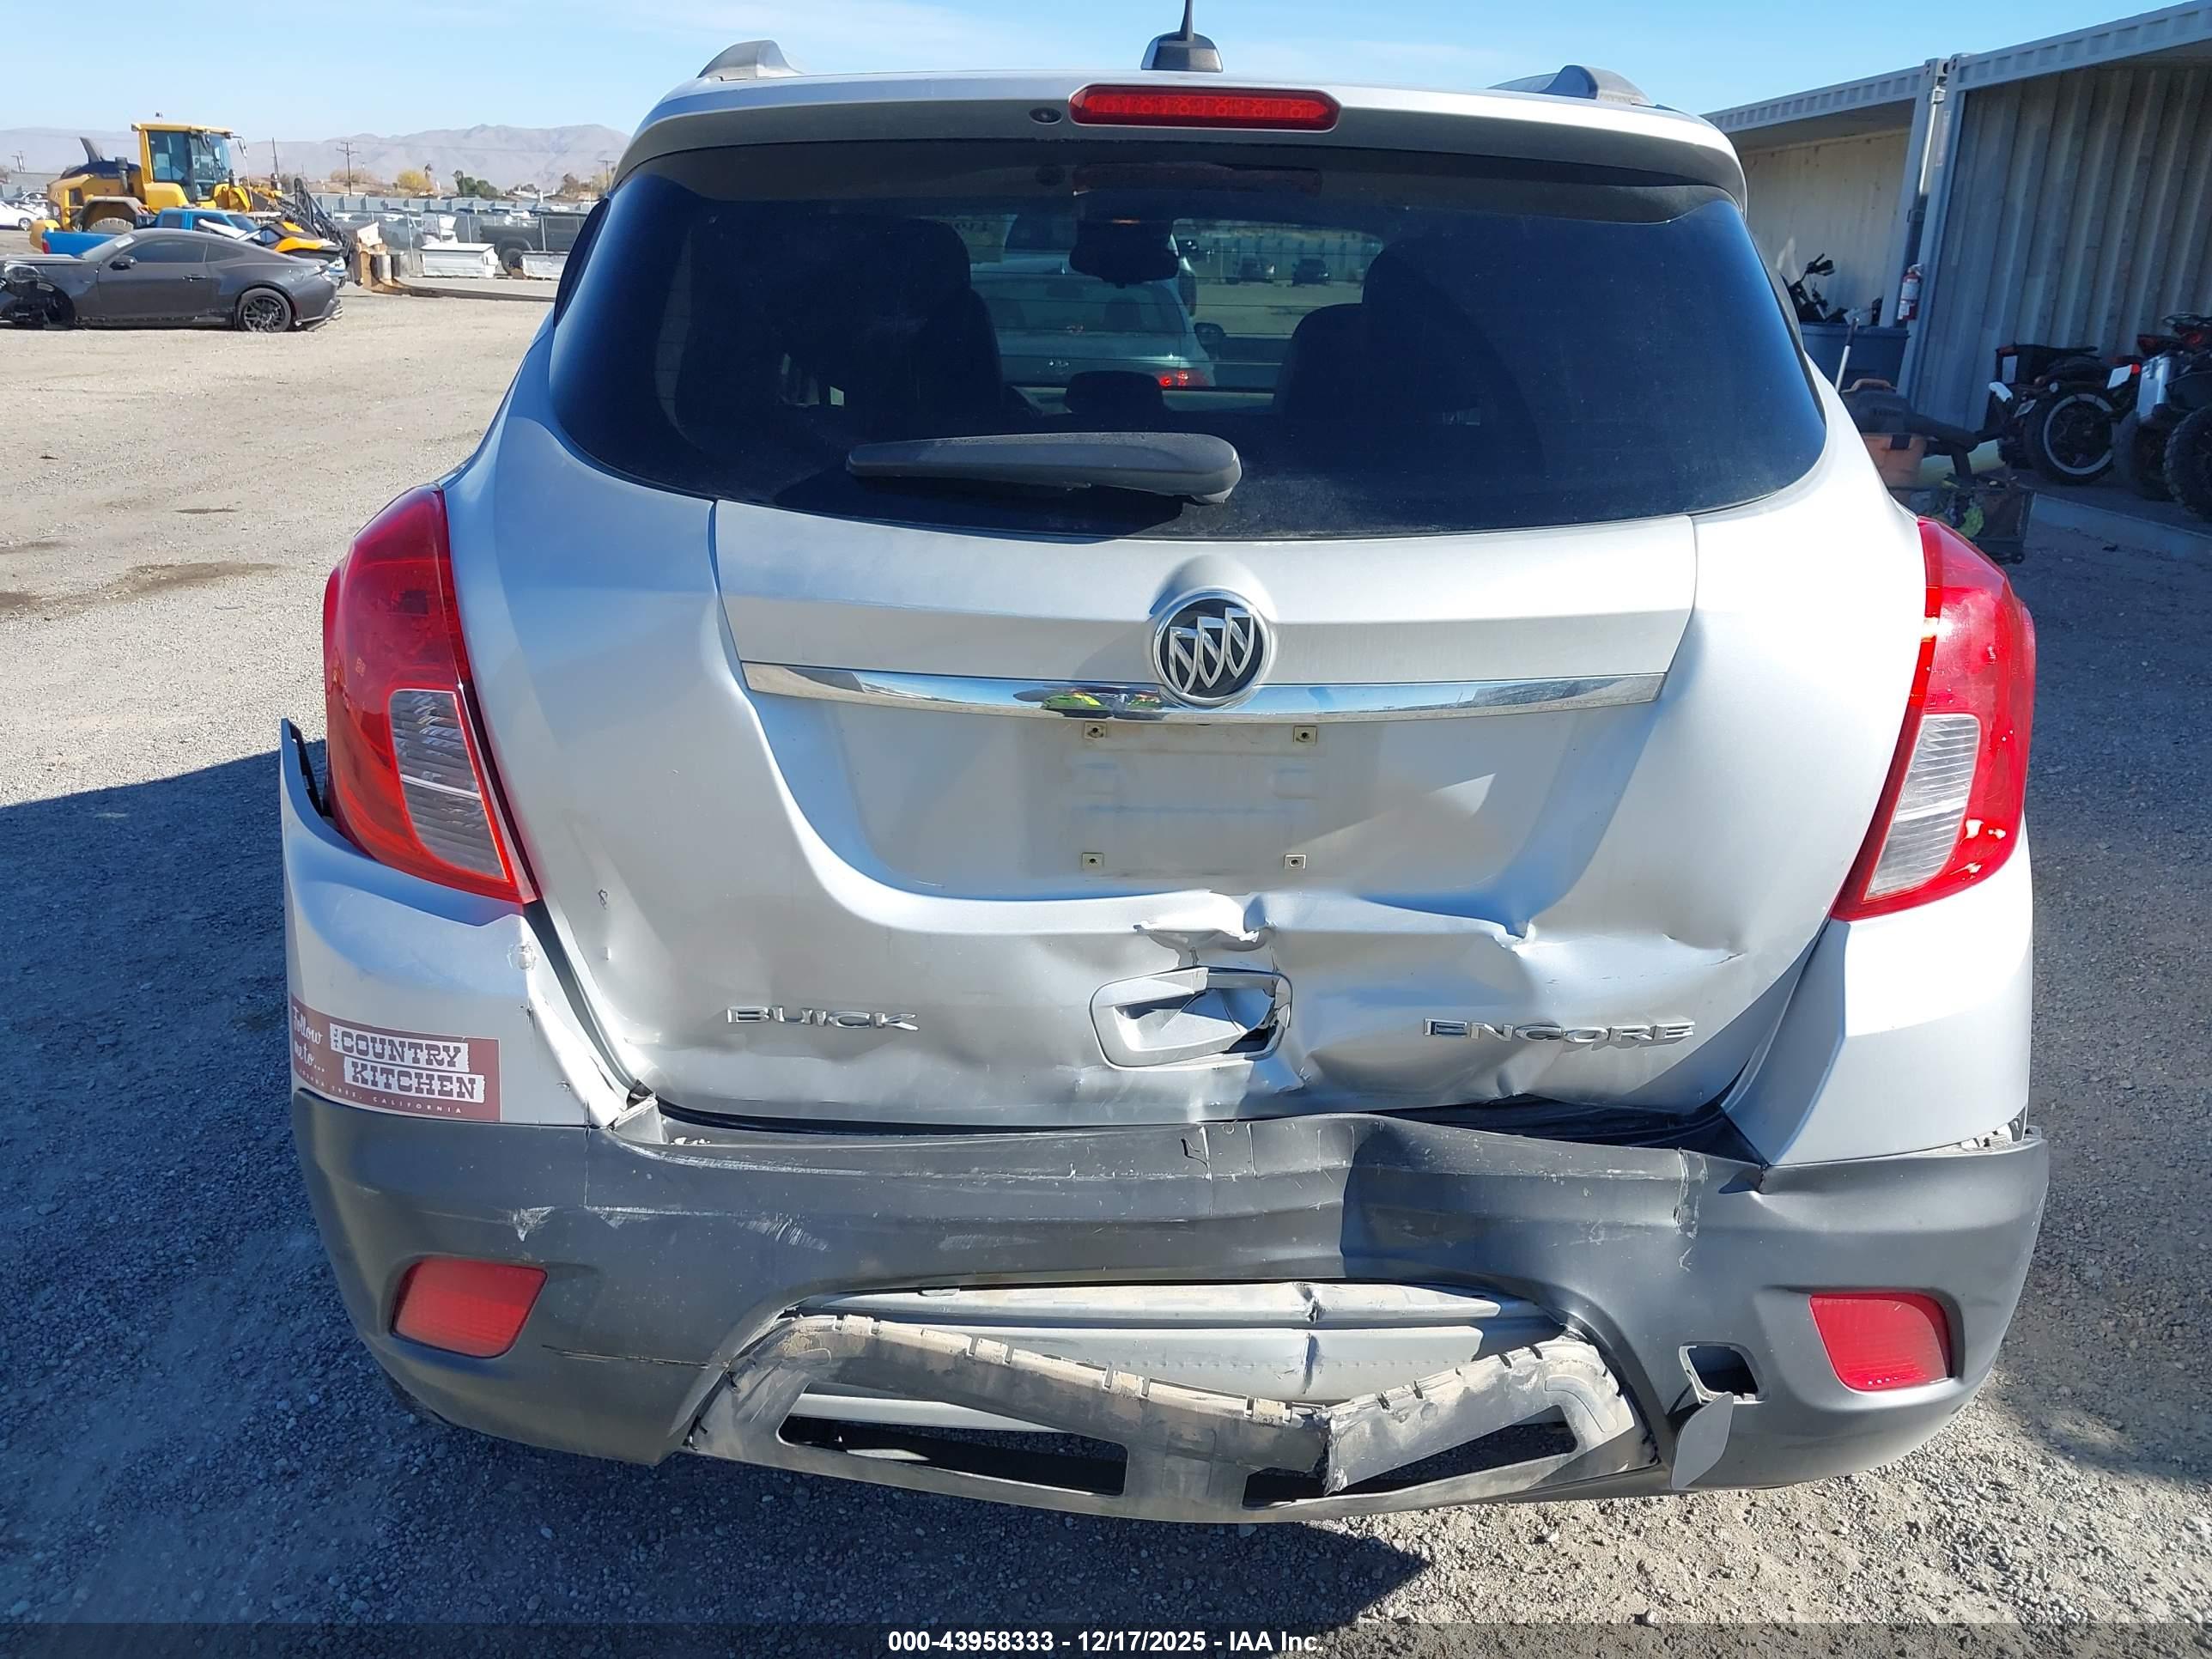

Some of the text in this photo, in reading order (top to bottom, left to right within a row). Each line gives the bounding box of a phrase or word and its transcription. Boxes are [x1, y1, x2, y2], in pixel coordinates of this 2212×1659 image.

[292, 1006, 323, 1044] Follow
[727, 1006, 920, 1030] BUICK
[1424, 1018, 1696, 1043] ENCORE
[341, 1031, 461, 1067] COUNTRY
[351, 1060, 477, 1099] KITCHEN
[373, 1097, 462, 1114] CALIFORNIA
